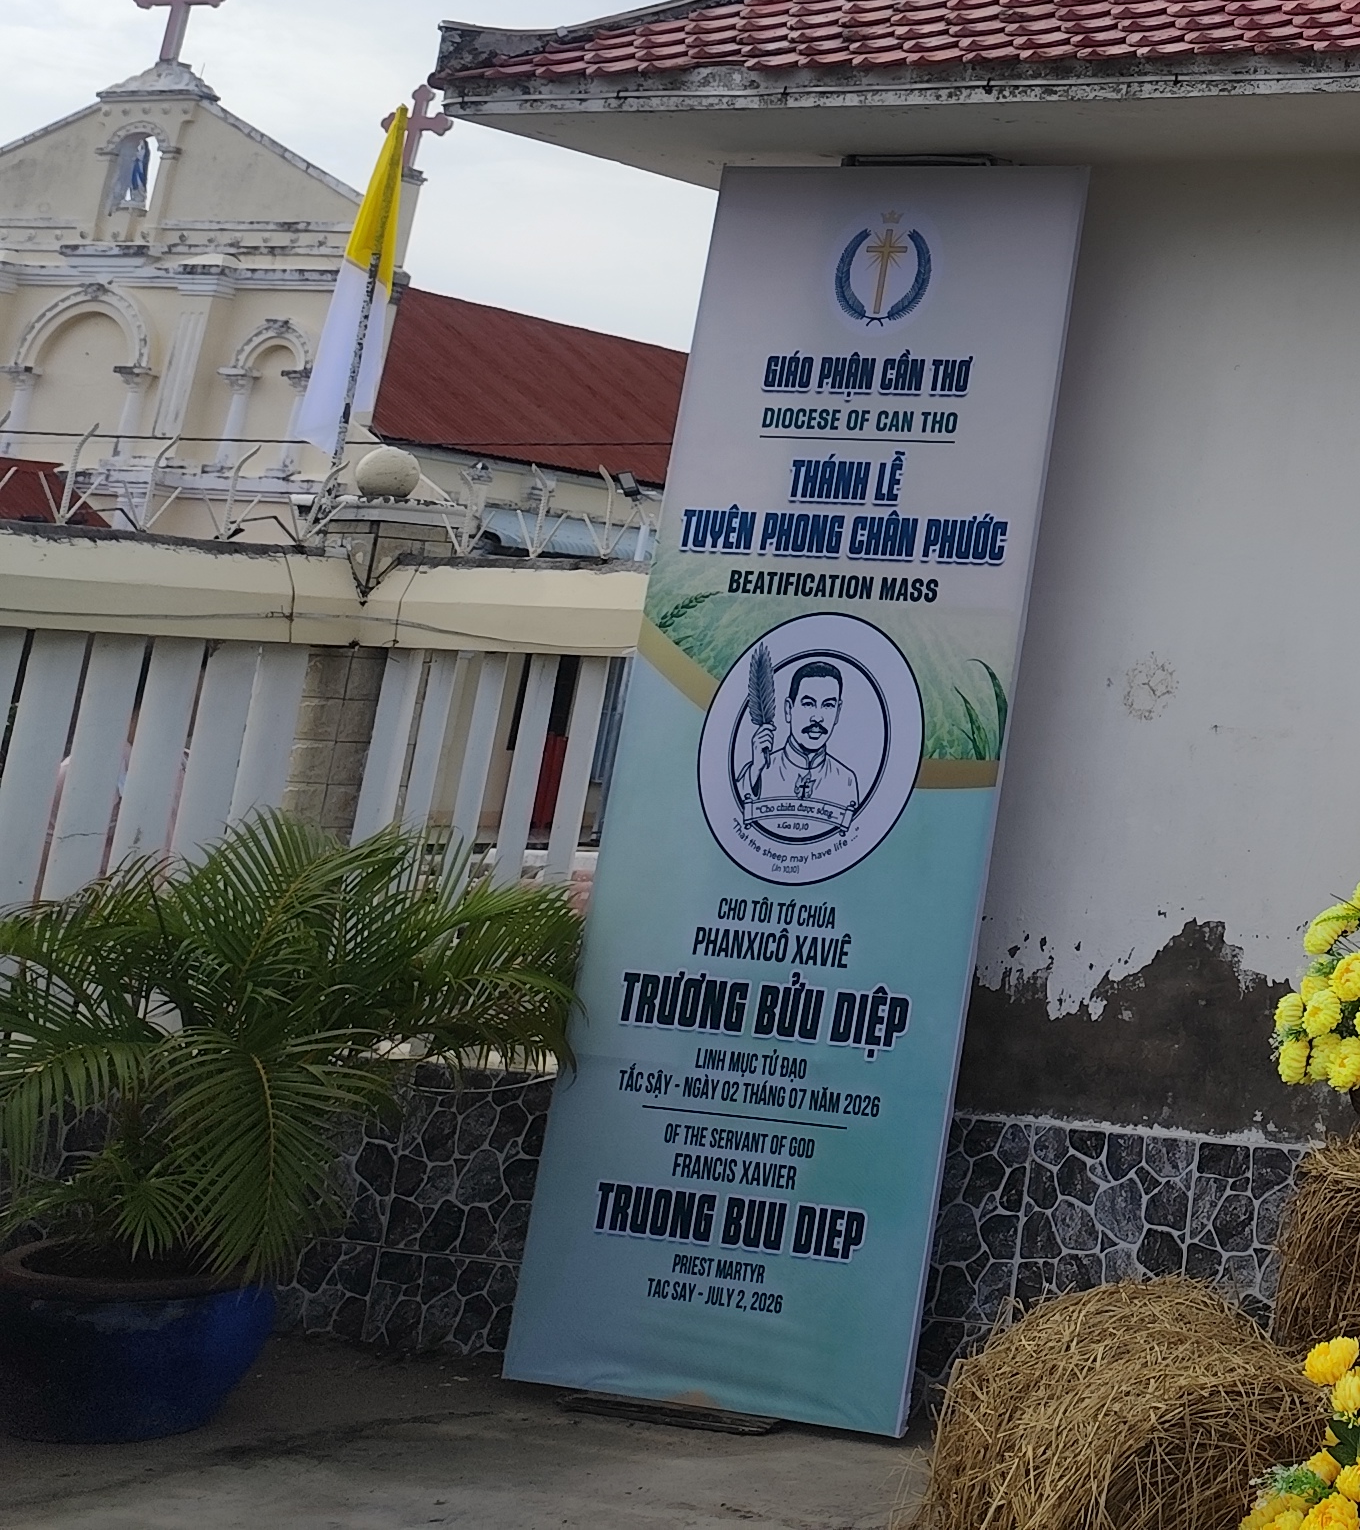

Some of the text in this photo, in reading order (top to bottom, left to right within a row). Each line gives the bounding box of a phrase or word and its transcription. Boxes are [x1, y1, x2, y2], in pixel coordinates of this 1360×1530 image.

[763, 348, 973, 397] GIÁO PHẬN CẦN THƠ
[761, 407, 959, 434] DIOCESE OF CAN THO
[790, 450, 905, 502] THÁNH LỄ
[681, 503, 1009, 561] TUYÊN PHONG CHÂN PHƯỚC
[728, 570, 940, 603] BEATIFICATION MASS
[748, 839, 761, 852] the
[762, 848, 787, 863] sheep
[790, 854, 809, 865] may
[811, 849, 832, 861] have
[834, 840, 848, 852] life
[717, 897, 836, 930] CHO TÔI TỚ CHÚA
[692, 926, 851, 969] PHANXICÔ XAVIÊ
[621, 972, 910, 1059] TRƯƠNG BỬU DIỆP
[695, 1048, 726, 1071] LINH
[729, 1051, 758, 1077] MỤC
[779, 1057, 808, 1082] ĐẠO
[619, 1063, 643, 1092] TẮC
[645, 1071, 673, 1104] SẬY
[683, 1077, 720, 1101] NGÀY
[721, 1080, 740, 1103] 02
[743, 1079, 786, 1108] THÁNG
[788, 1087, 806, 1109] 07
[809, 1086, 841, 1114] NĂM
[843, 1093, 881, 1118] 2026
[664, 1123, 815, 1160] OF THE SERVANT OF GOD
[672, 1152, 797, 1190] FRANCIS XAVIER
[596, 1182, 866, 1261] TRUONG BUU DIEP
[672, 1253, 766, 1284] PRIEST MARTYR
[647, 1278, 671, 1299] TAC
[672, 1281, 696, 1303] SAY
[704, 1285, 736, 1308] JULY
[736, 1289, 748, 1312] 2,
[749, 1292, 783, 1314] 2026
